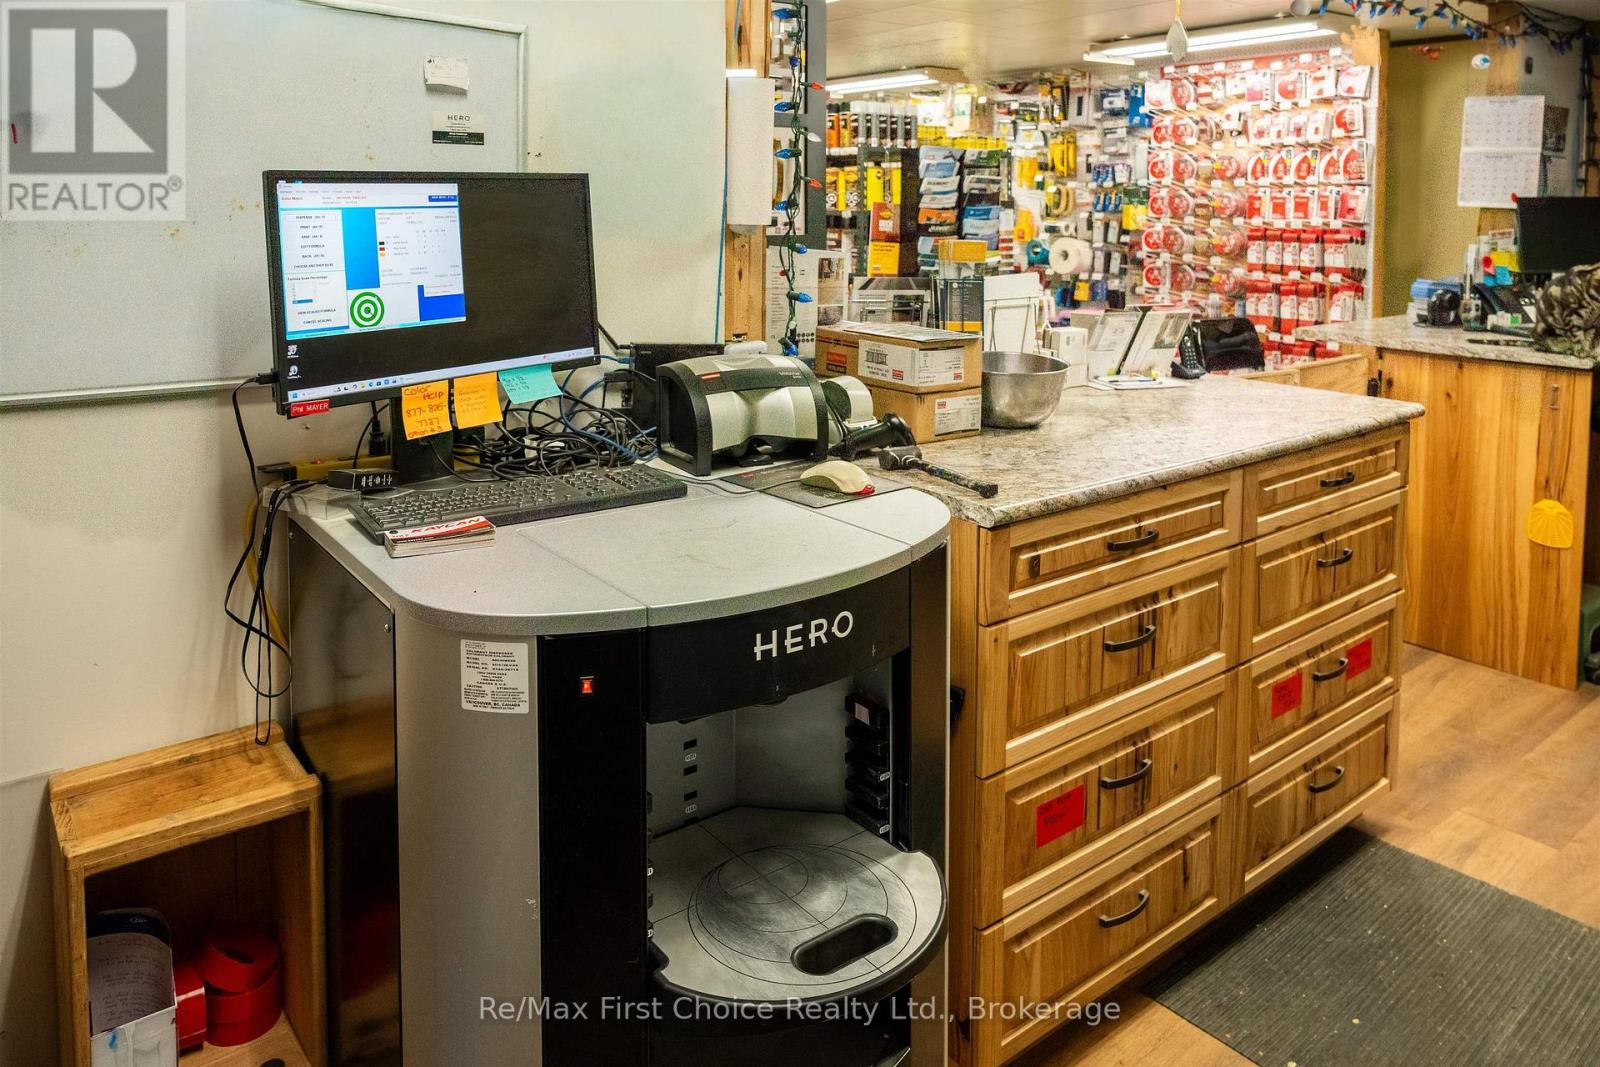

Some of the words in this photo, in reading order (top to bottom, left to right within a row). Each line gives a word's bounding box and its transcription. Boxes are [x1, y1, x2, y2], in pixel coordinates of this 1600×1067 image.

[447, 114, 471, 122] HERO
[404, 385, 431, 396] Color
[306, 402, 329, 412] MAYER
[753, 610, 854, 661] HERO
